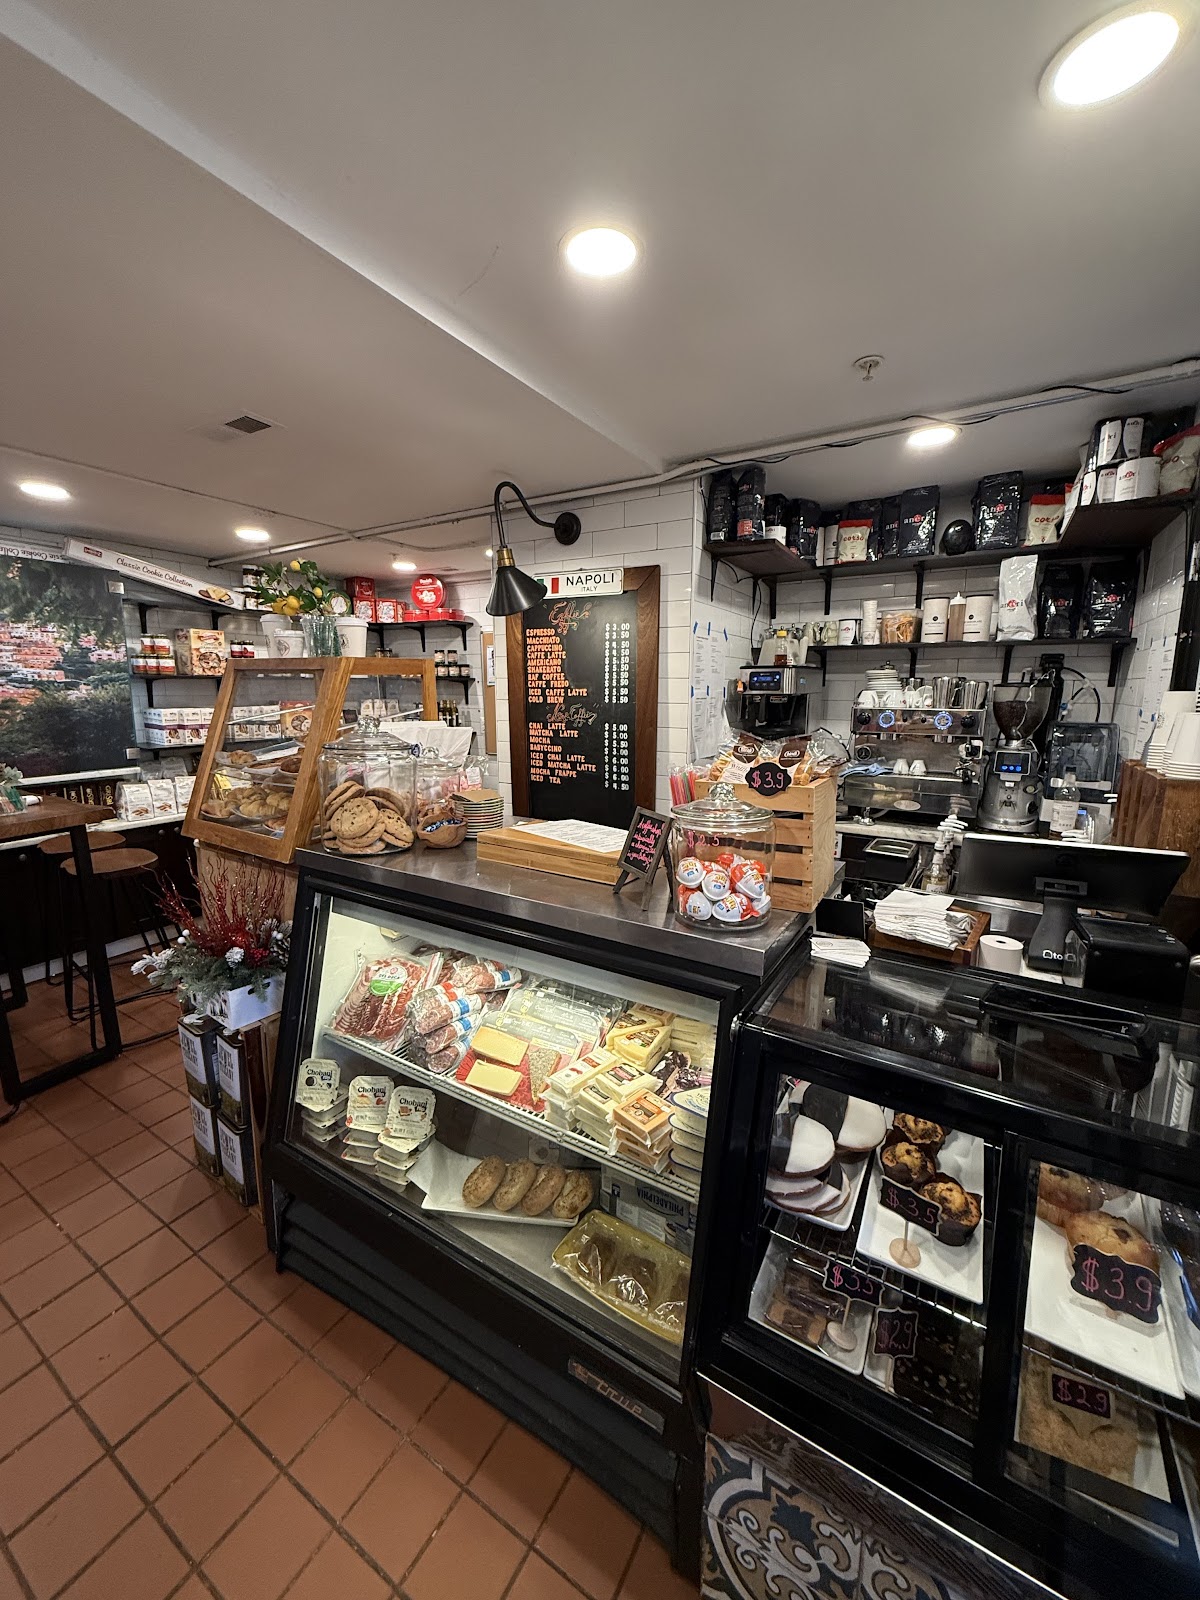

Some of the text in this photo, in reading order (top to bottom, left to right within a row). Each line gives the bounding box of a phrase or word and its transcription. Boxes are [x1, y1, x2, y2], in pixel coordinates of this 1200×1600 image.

[116, 557, 193, 587] Classic Cookie Collection
[566, 572, 614, 586] NAPOLI
[526, 628, 555, 636] ESPRESSO
[527, 644, 562, 652] CAPPUCCINO
[548, 651, 566, 659] LATTE
[568, 688, 587, 696] LATTE
[548, 722, 566, 730] LATTE
[529, 729, 553, 737] MATCHA
[530, 744, 562, 752] BABYCCINO
[567, 754, 585, 762] LATTE
[531, 759, 596, 772] ICED MATCHA LATTE
[555, 769, 577, 778] FRAPPE
[751, 770, 784, 788] $3.9
[688, 830, 722, 848] $2.5
[358, 1086, 386, 1094] Chobani
[400, 1098, 428, 1108] Chobani
[637, 1186, 684, 1216] PHILADELPHIA
[1080, 1256, 1153, 1312] $3.9
